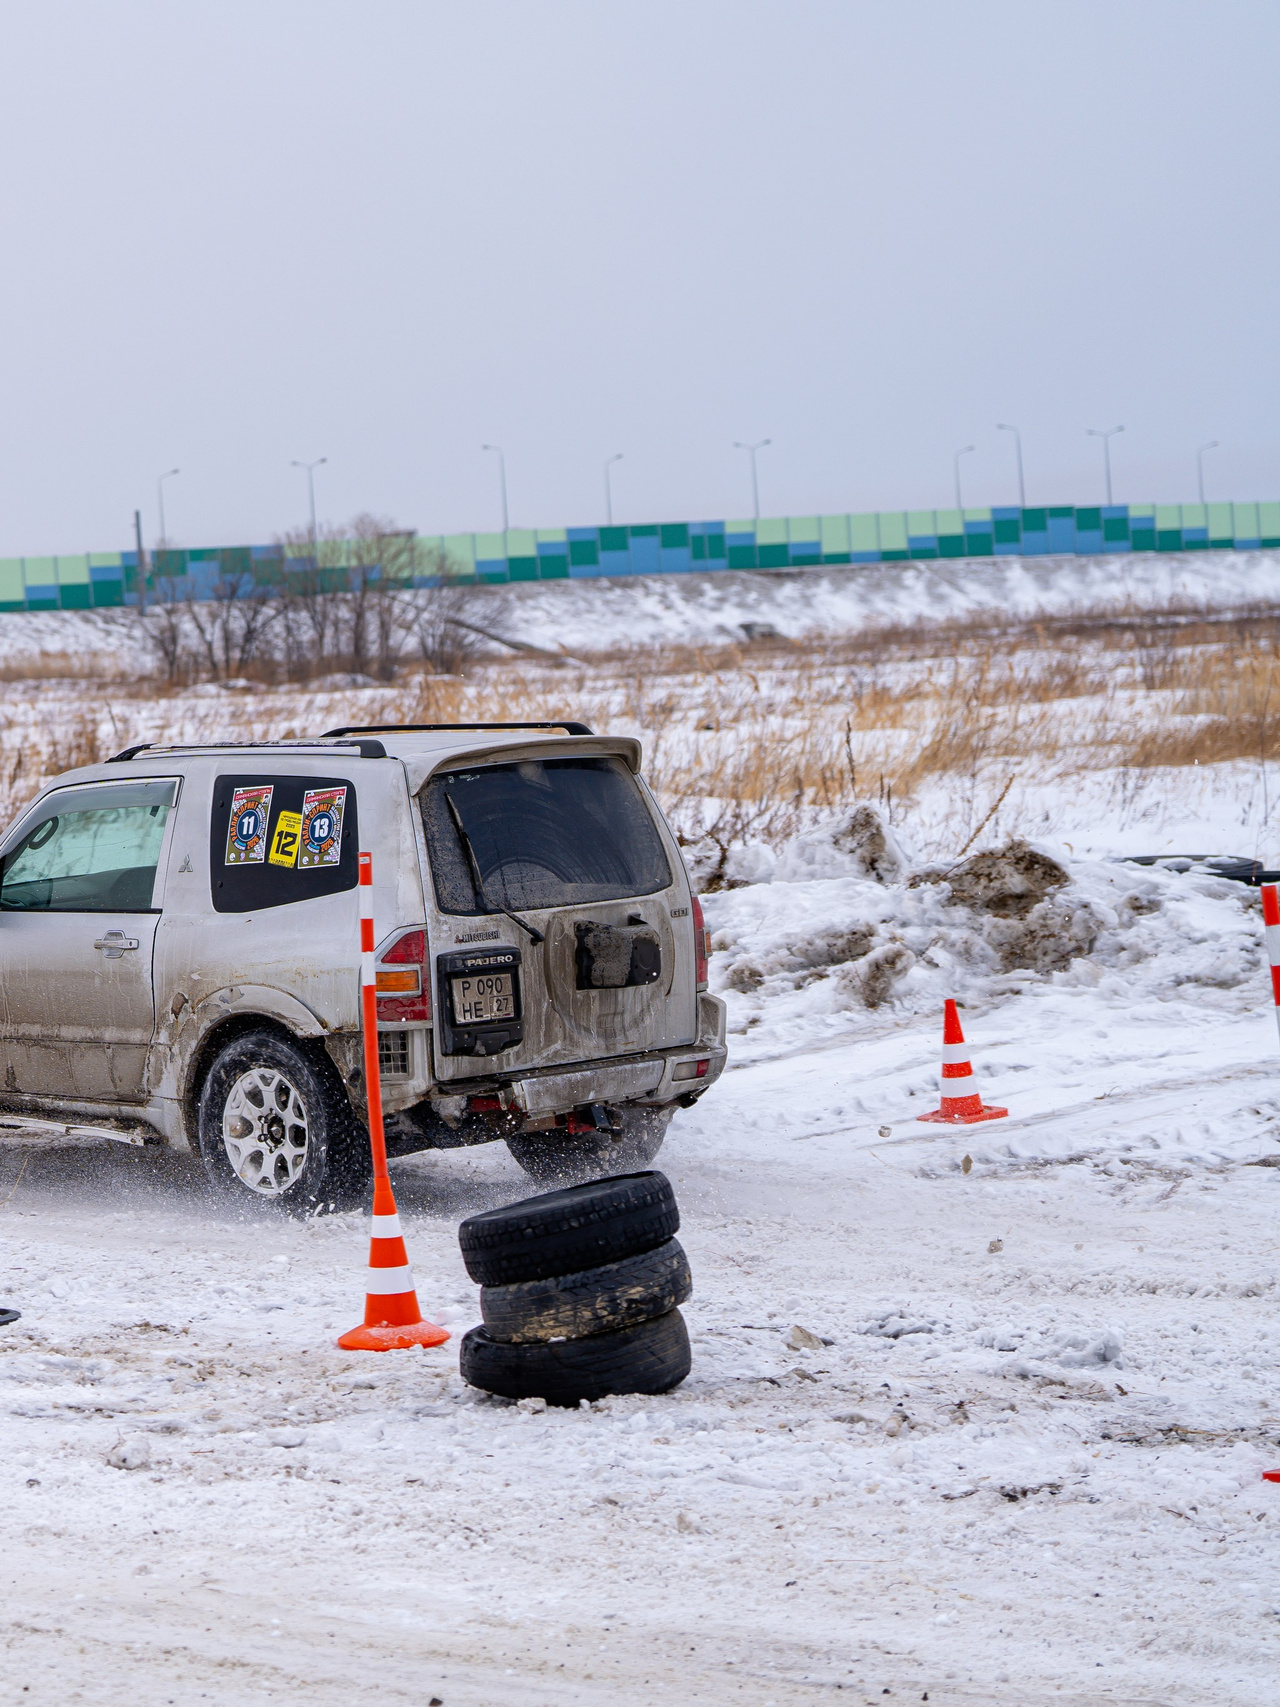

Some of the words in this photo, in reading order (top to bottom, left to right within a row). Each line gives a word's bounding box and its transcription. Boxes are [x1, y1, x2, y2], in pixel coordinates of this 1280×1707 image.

[242, 816, 255, 835] 11
[313, 818, 329, 838] 13
[275, 830, 298, 857] 12
[462, 930, 500, 943] MITSUBISHI
[467, 955, 513, 967] PAJERO
[461, 981, 471, 998] Р
[477, 977, 503, 996] 090
[462, 1001, 484, 1020] НЕ
[495, 998, 509, 1012] 27
